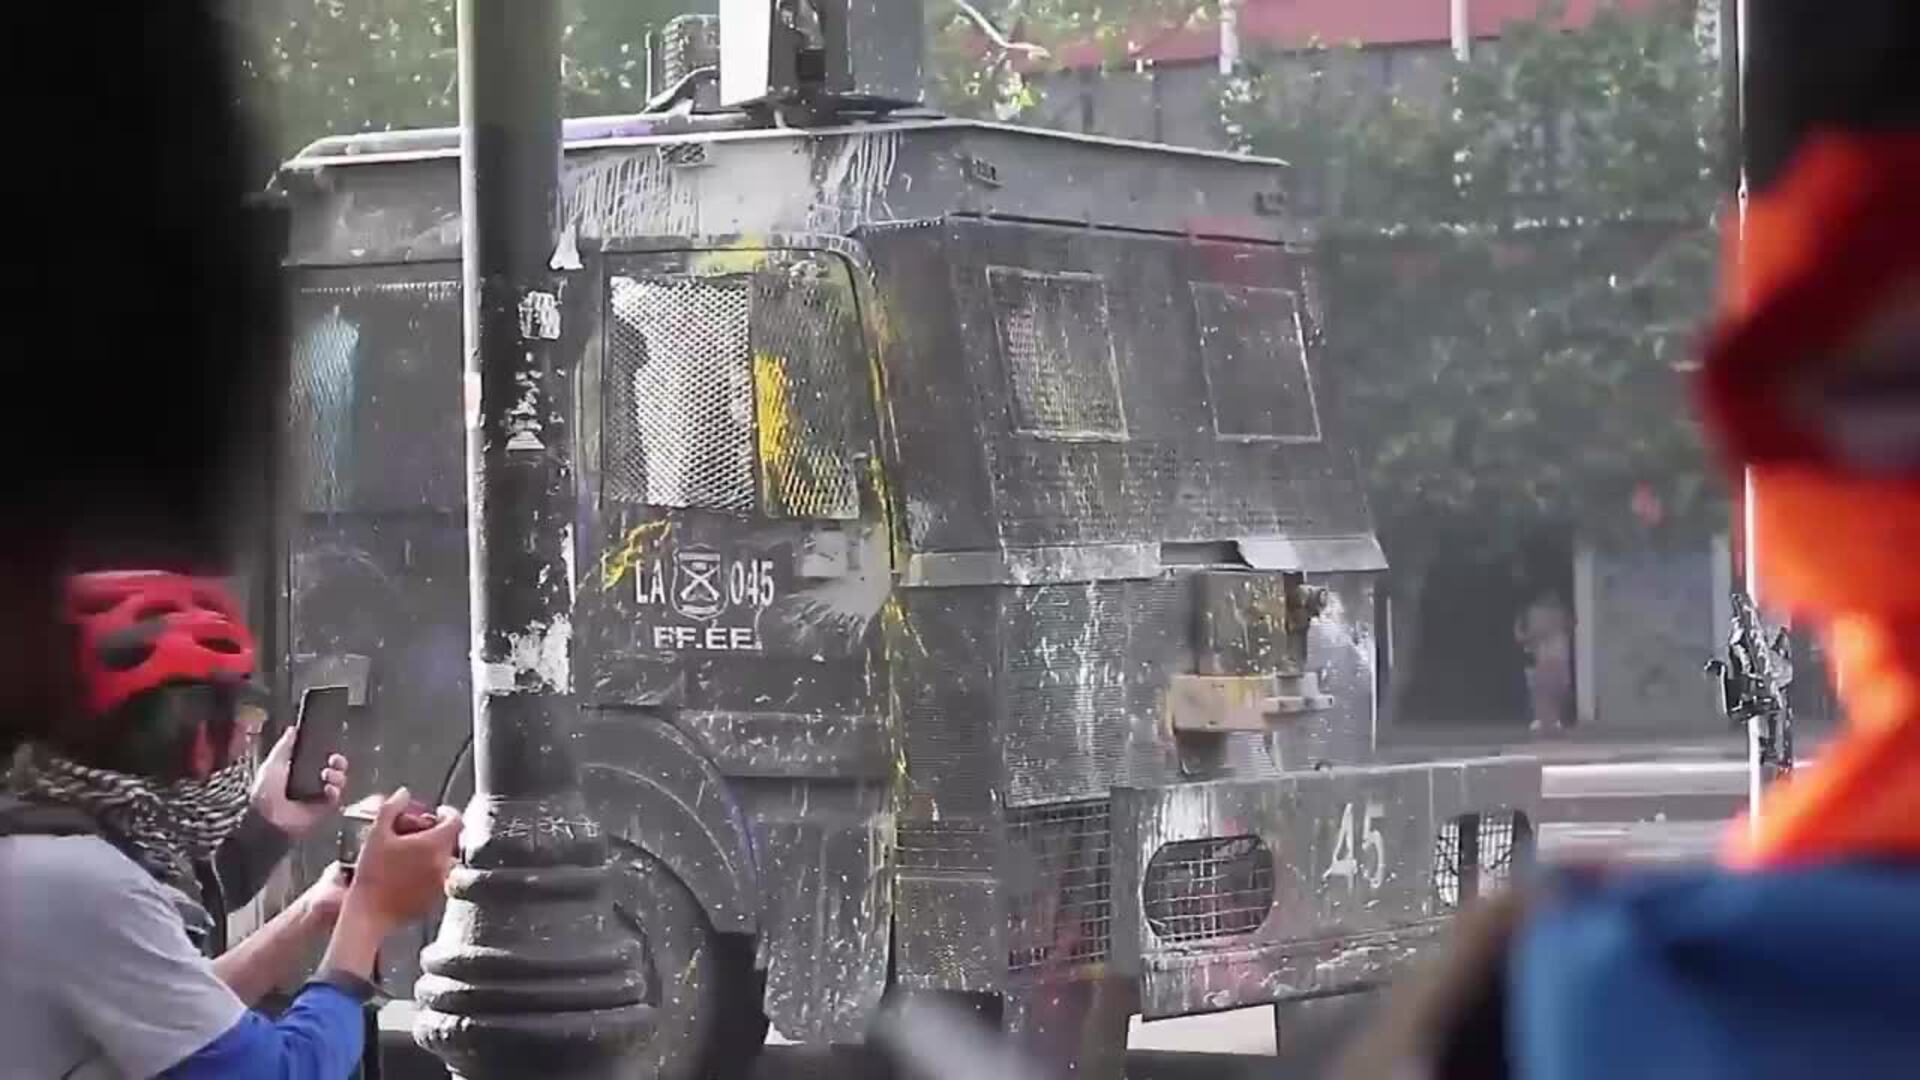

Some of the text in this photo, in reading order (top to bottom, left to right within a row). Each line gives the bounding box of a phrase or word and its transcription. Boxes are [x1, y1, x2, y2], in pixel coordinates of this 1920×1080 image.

[635, 559, 775, 606] LA 045
[1323, 802, 1384, 889] 45
